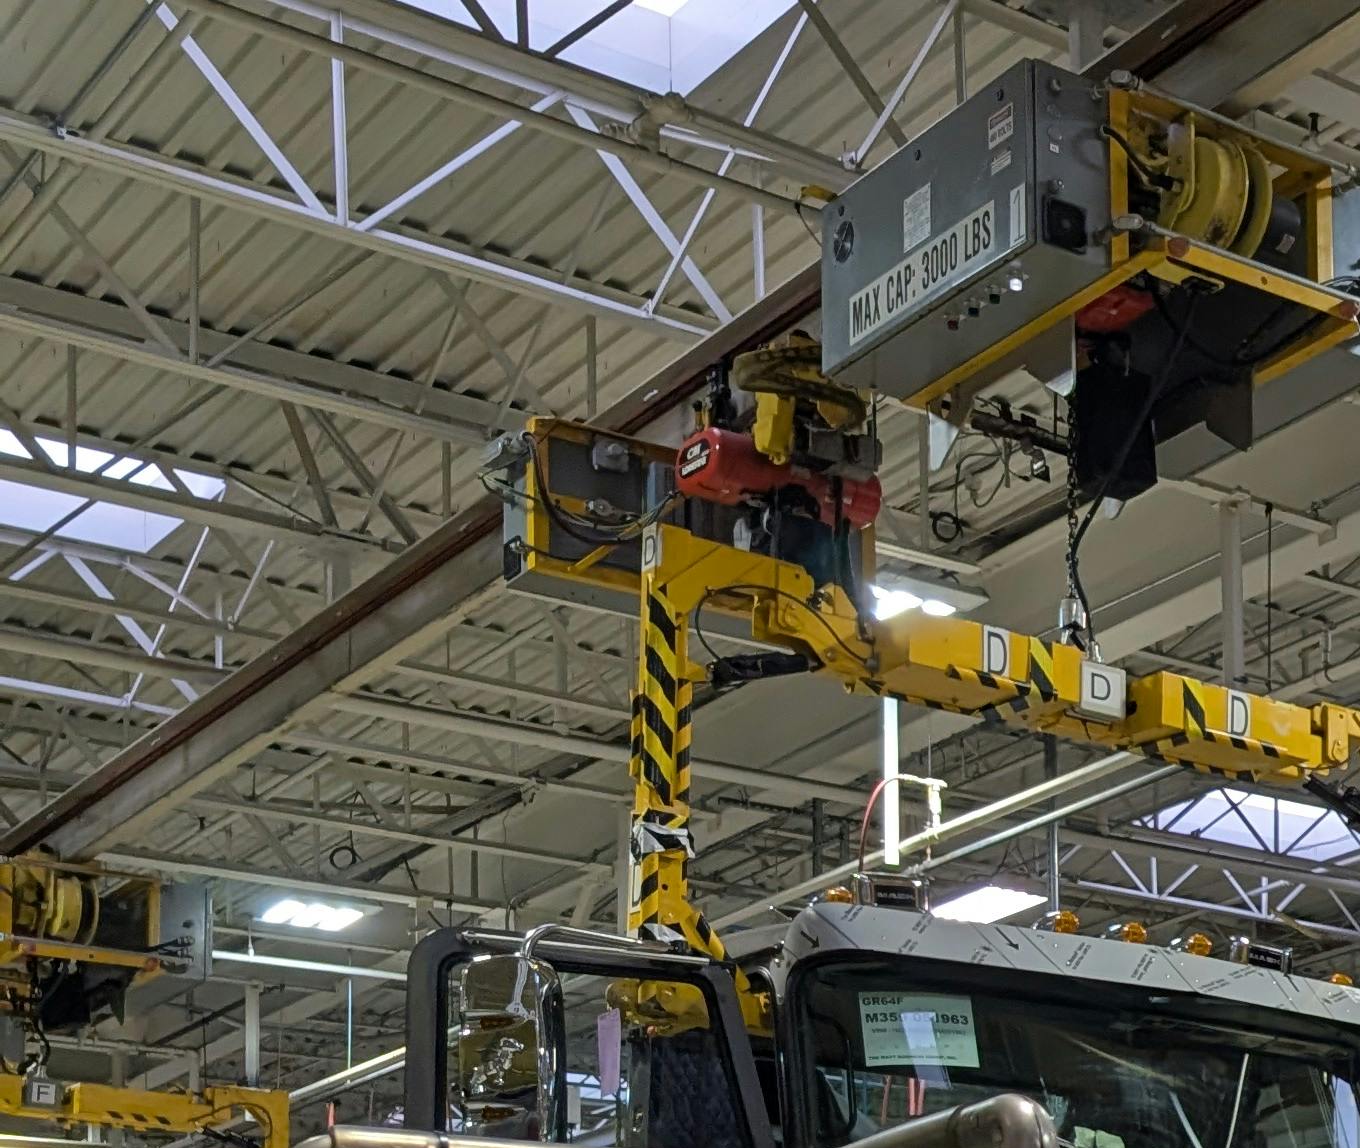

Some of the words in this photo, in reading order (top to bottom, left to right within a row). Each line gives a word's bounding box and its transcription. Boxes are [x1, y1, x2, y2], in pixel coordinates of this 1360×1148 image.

[1013, 189, 1025, 243] 1
[852, 285, 881, 338] MAX
[886, 260, 916, 318] CAP:
[921, 231, 958, 291] 3000
[964, 210, 991, 264] LBS
[644, 534, 656, 565] D
[987, 631, 1008, 675] D
[1090, 672, 1111, 701] D
[1230, 695, 1248, 737] D
[862, 996, 904, 1006] GR64F
[37, 1084, 51, 1102] F
